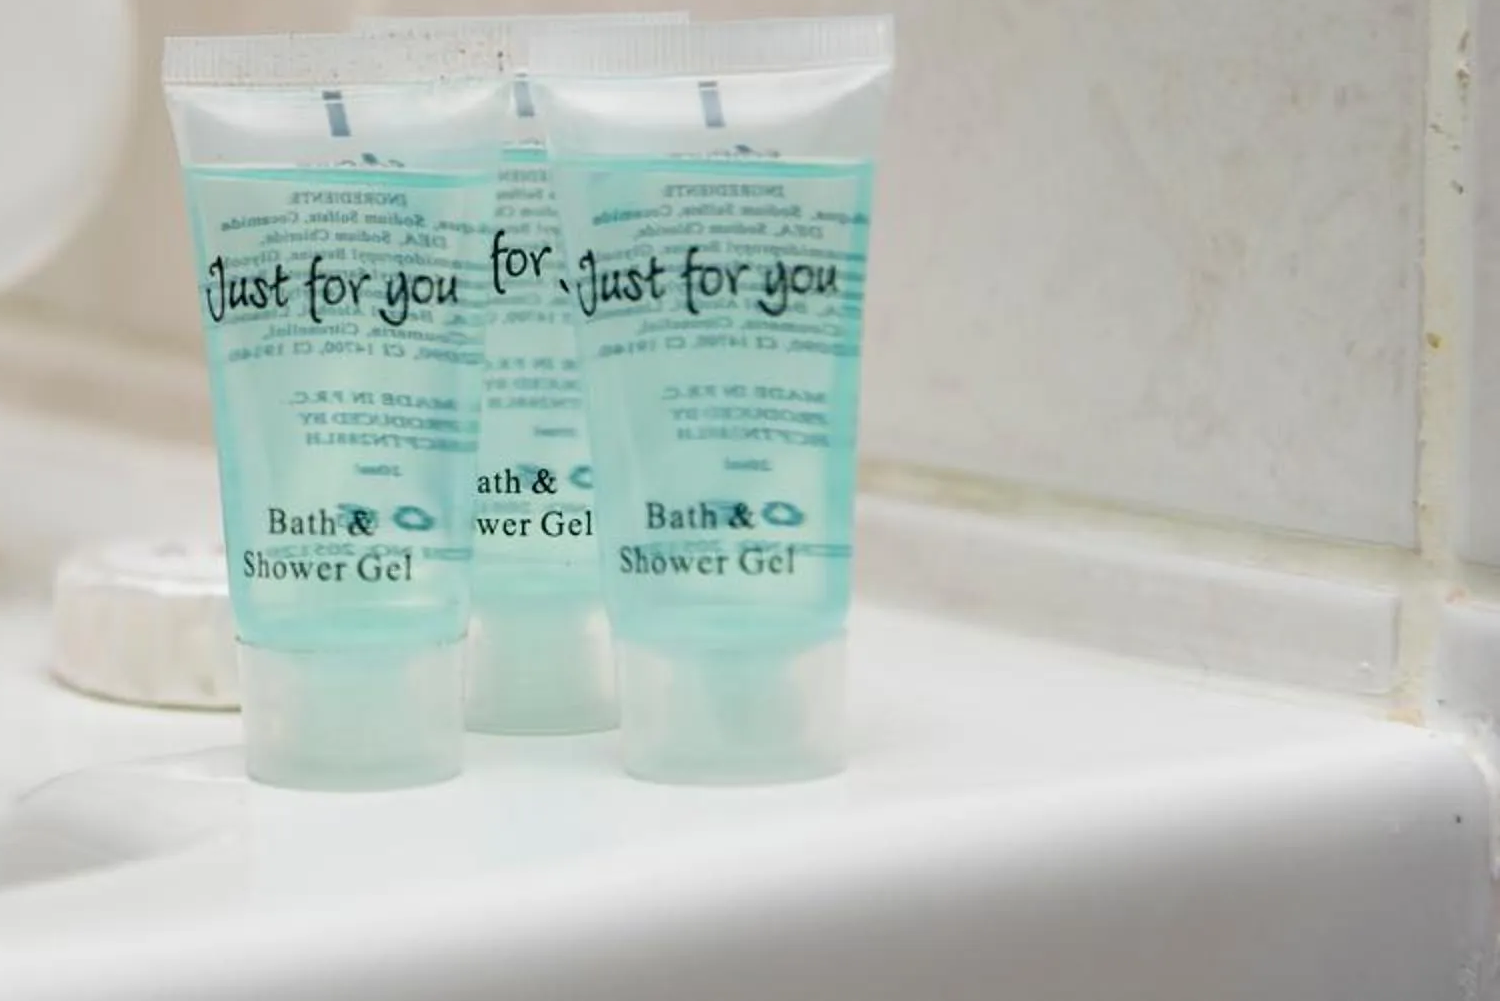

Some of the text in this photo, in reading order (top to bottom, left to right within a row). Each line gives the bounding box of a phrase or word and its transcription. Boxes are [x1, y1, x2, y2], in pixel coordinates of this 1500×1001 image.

[490, 229, 553, 295] for
[206, 254, 459, 327] Just for you
[577, 246, 840, 317] Just for you
[477, 468, 558, 495] ath &
[267, 507, 376, 537] Bath &
[540, 509, 594, 538] Gel
[645, 501, 756, 531] Bath &
[243, 549, 348, 582] Shower
[356, 553, 414, 584] Gel
[619, 544, 729, 576] Shower
[738, 542, 797, 577] Gel
